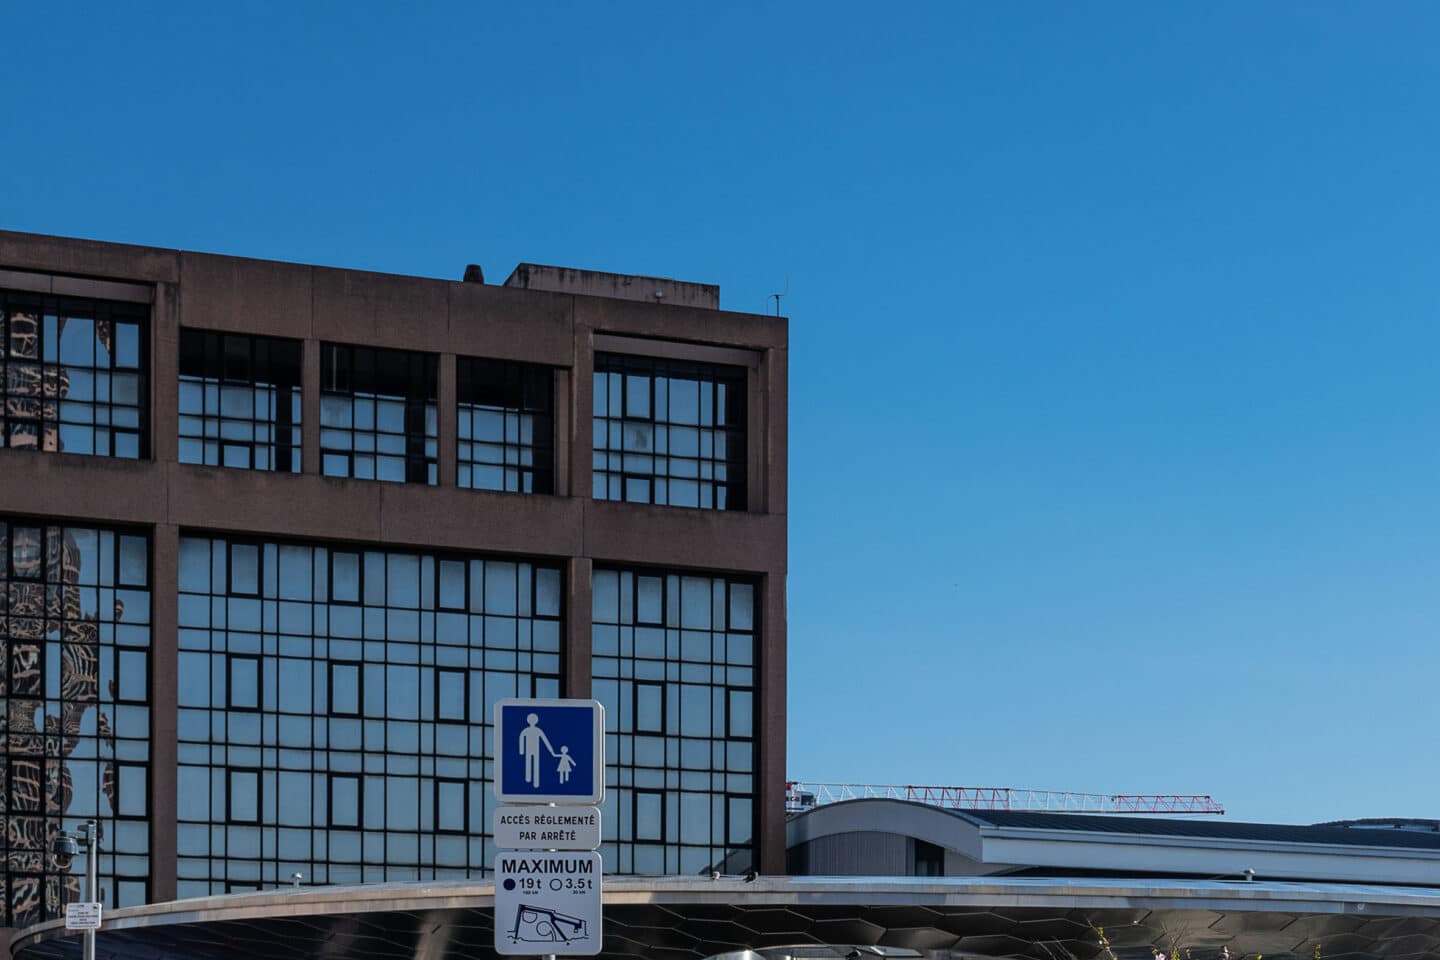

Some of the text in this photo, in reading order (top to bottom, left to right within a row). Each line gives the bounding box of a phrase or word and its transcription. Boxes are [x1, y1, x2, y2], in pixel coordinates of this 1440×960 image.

[534, 814, 595, 825] RÉGLEMENTÉ
[519, 829, 576, 840] PAR ARRÊTÉ
[502, 859, 593, 873] MAXIMUM
